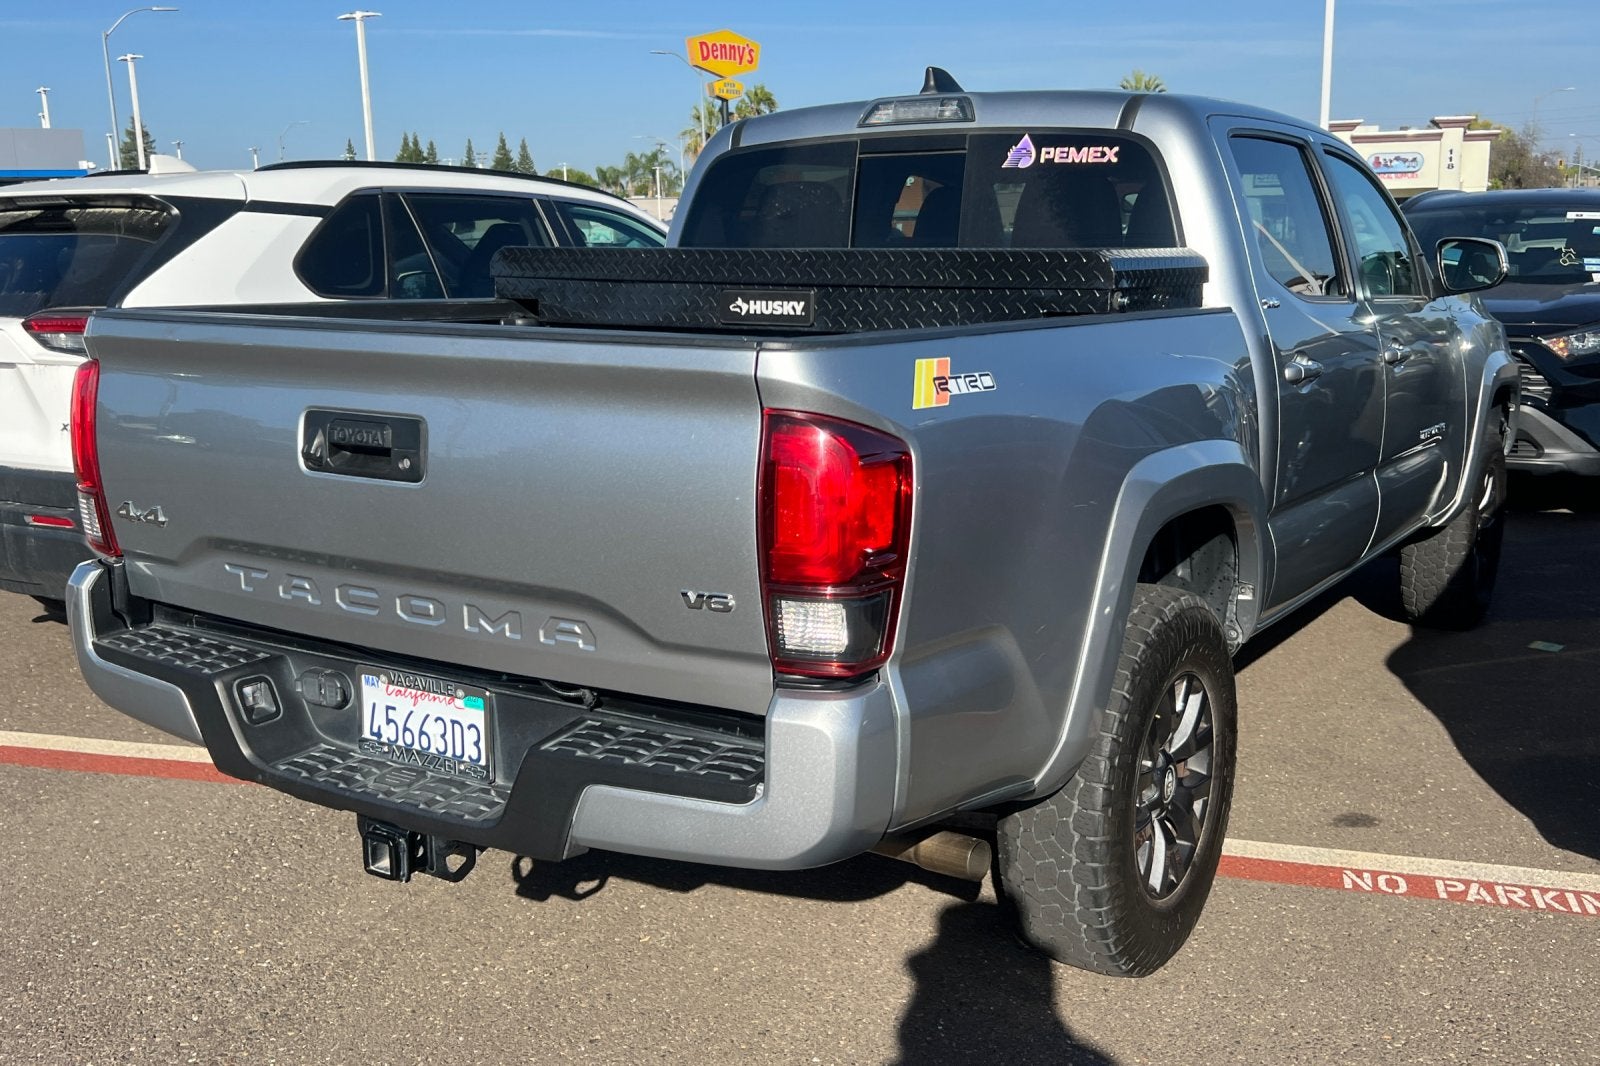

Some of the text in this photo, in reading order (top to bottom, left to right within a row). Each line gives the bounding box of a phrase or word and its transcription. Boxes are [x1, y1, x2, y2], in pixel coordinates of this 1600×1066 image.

[698, 41, 755, 66] Denny's
[1040, 146, 1119, 164] PEMEX
[329, 426, 384, 447] TOYOTA
[224, 562, 597, 651] TACOMA
[680, 589, 736, 613] V6
[363, 675, 380, 688] MAY
[389, 671, 455, 697] VACAVILLE
[386, 683, 465, 710] California
[369, 702, 482, 764] 45663D3
[391, 745, 459, 775] MAZZEI
[1343, 870, 1408, 894] NO
